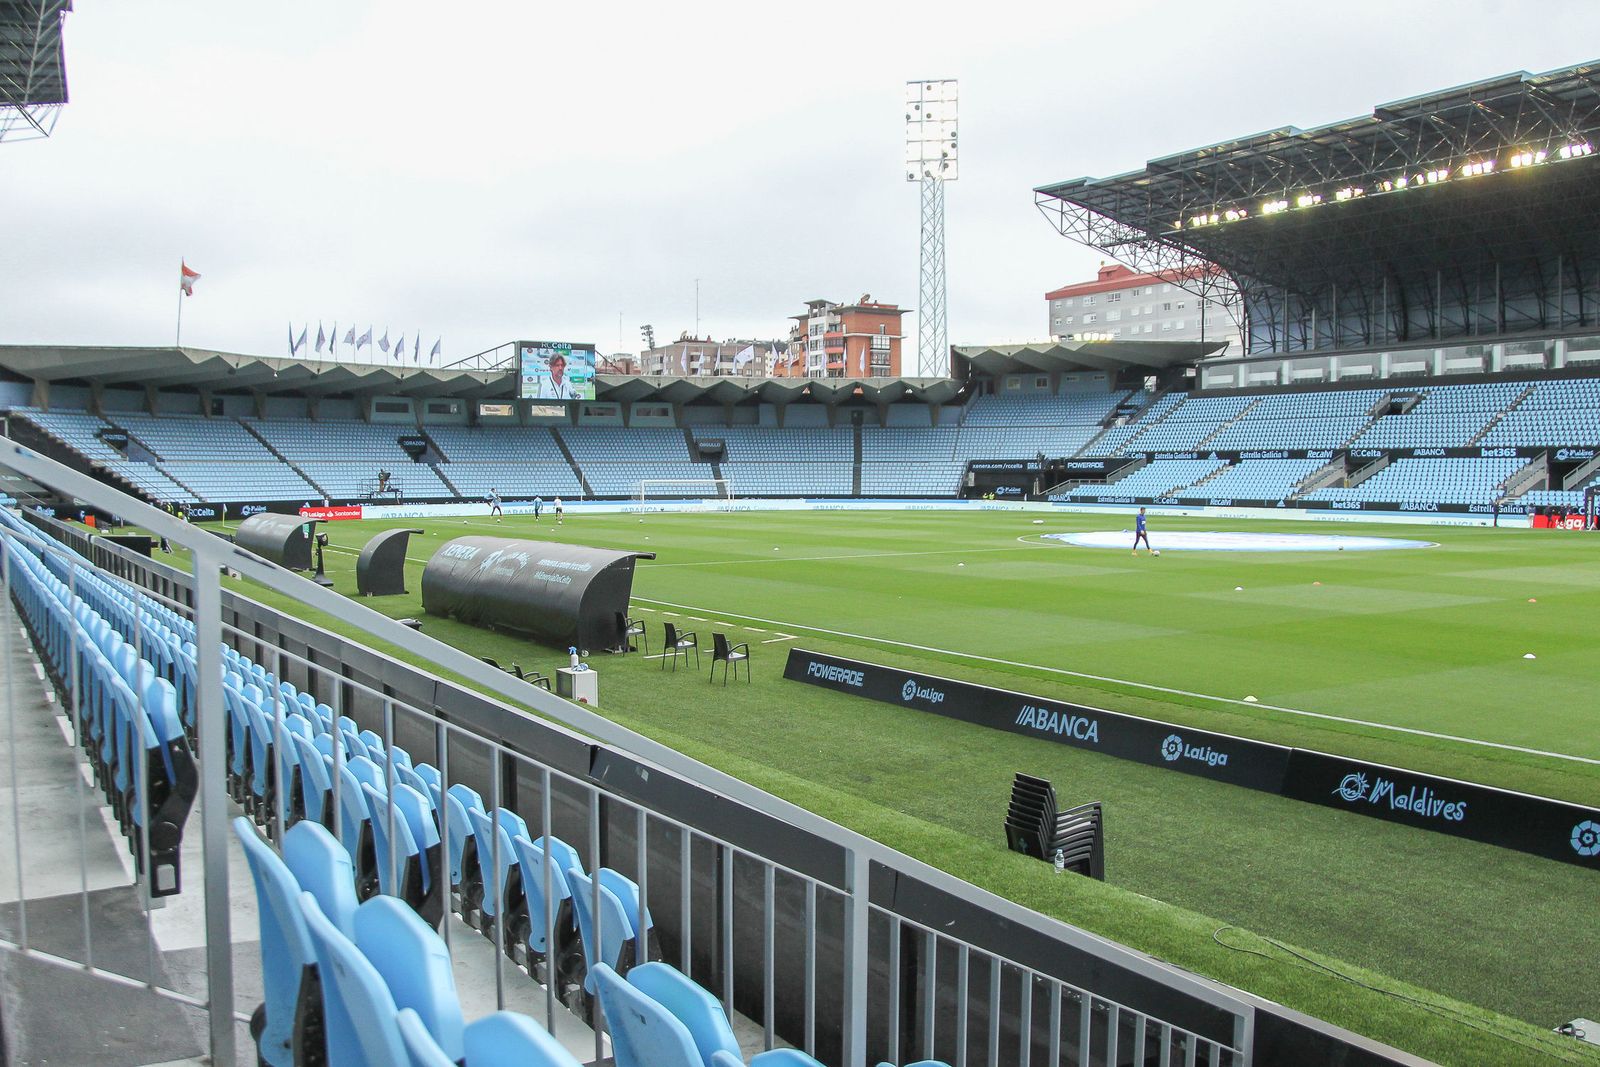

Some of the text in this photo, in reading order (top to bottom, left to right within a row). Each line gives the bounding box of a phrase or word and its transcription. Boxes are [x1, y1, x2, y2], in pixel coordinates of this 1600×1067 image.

[1481, 447, 1516, 457] bet365
[1332, 501, 1361, 509] bet365
[807, 661, 865, 687] POWERADE
[916, 687, 945, 704] LaLiga
[1019, 705, 1099, 743] ABANCA
[1183, 744, 1229, 767] LaLiga
[1368, 777, 1467, 822] Maldives
